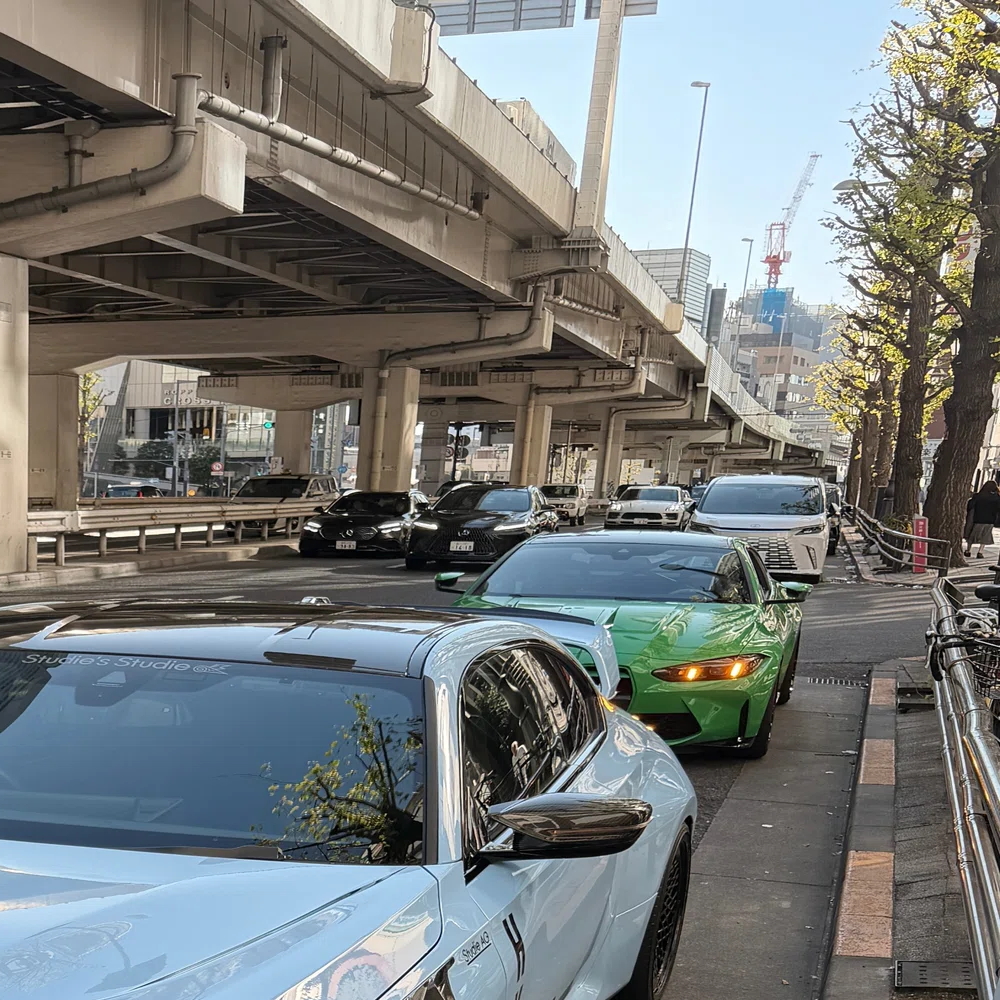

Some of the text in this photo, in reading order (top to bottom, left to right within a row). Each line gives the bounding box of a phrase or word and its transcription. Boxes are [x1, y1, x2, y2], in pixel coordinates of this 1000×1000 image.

[21, 653, 191, 672] Studie's Studie
[461, 940, 481, 963] Studie
